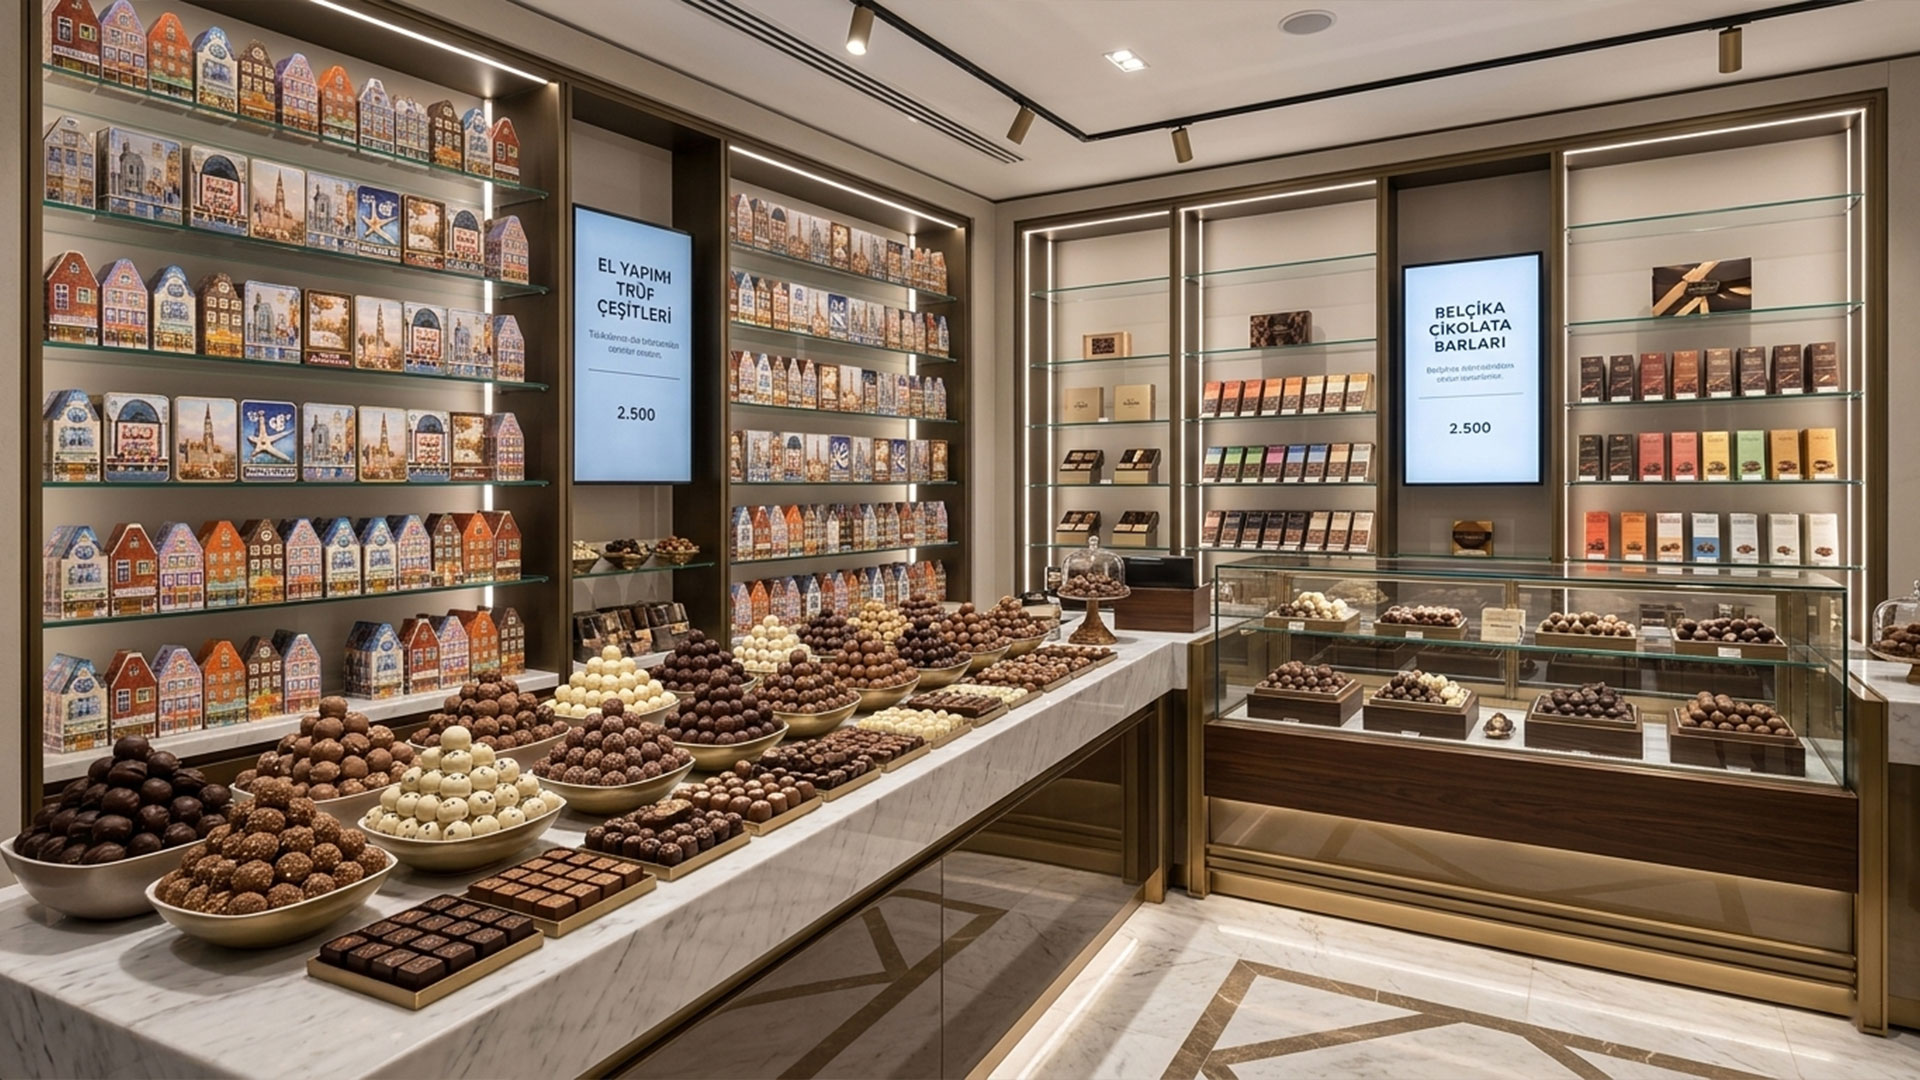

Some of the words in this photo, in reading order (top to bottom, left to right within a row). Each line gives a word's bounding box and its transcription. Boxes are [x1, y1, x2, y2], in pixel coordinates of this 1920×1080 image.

[598, 257, 616, 274] EL
[597, 299, 672, 324] ÇEŞİTLERİ
[1435, 300, 1506, 320] BELÇİKA
[1435, 336, 1506, 353] BARLARI
[617, 405, 656, 422] 2.500
[1449, 421, 1492, 434] 2.500
